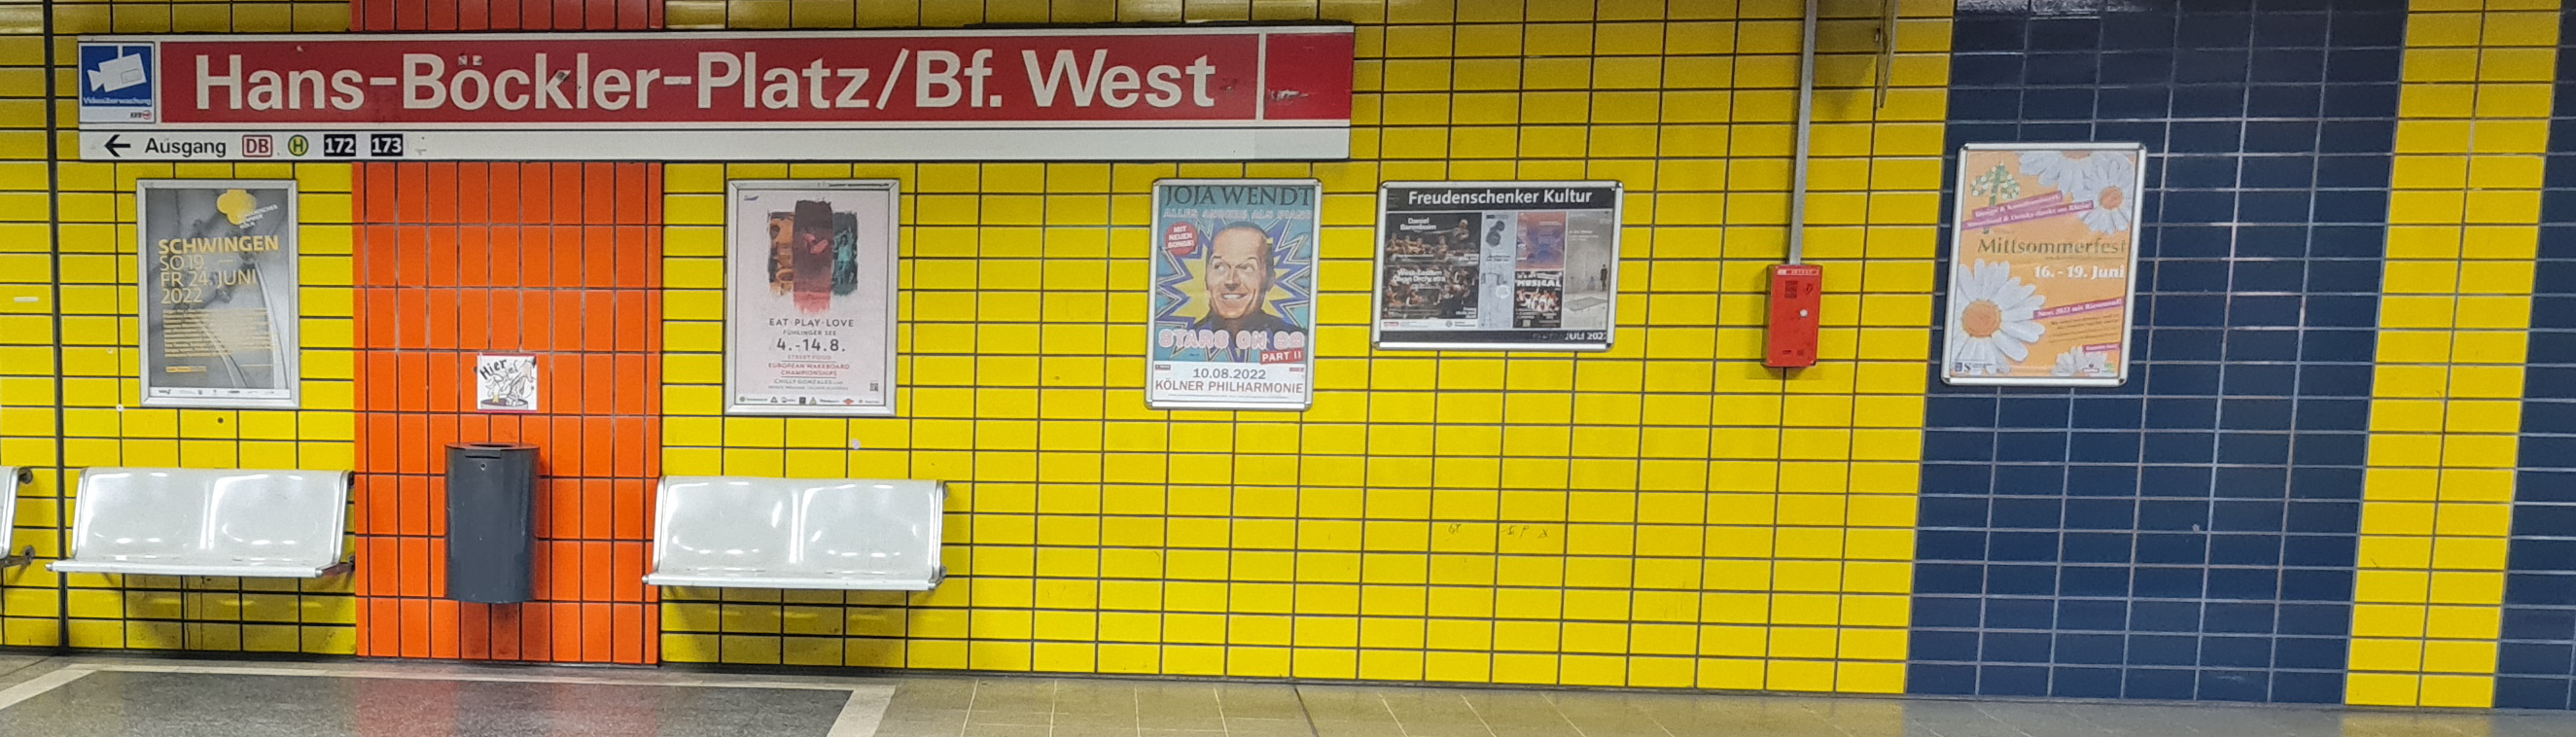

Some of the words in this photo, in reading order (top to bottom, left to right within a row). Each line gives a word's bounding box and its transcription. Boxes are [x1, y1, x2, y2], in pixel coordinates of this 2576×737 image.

[1021, 49, 1217, 108] West
[144, 137, 227, 158] Ausgang
[245, 138, 270, 154] DB
[293, 138, 304, 153] H
[325, 137, 356, 154] 172
[371, 137, 403, 154] 173
[1165, 185, 1217, 207] JOJA
[1222, 186, 1315, 207] WENDT
[1408, 190, 1539, 205] Freudenschenker
[1543, 189, 1593, 203] Kultur
[1173, 225, 1187, 233] MIT
[158, 234, 279, 255] SCHWINGEN
[1977, 237, 2126, 255] Mittsommerfest
[159, 255, 185, 271] SO
[160, 271, 184, 288] FR
[188, 270, 213, 287] 24.
[216, 268, 258, 289] JUNI
[2033, 265, 2055, 278] 16.
[2066, 265, 2089, 279] 19.
[2091, 265, 2126, 280] Juni
[1516, 279, 1562, 288] MUSICAL
[160, 288, 203, 304] 2022
[768, 318, 789, 327] EAT
[794, 318, 821, 327] PLAY
[826, 319, 855, 328] LOVE
[1158, 329, 1230, 349] STARS
[1235, 330, 1268, 351] ON
[1565, 332, 1585, 340] JULI
[776, 337, 846, 352] 4.-14.8.
[1261, 352, 1291, 363] PART
[478, 359, 508, 380] Hier
[1192, 368, 1267, 380] 10.08.2022
[1155, 377, 1205, 391] KÖLNER
[1208, 380, 1304, 394] PHILHARMONIE
